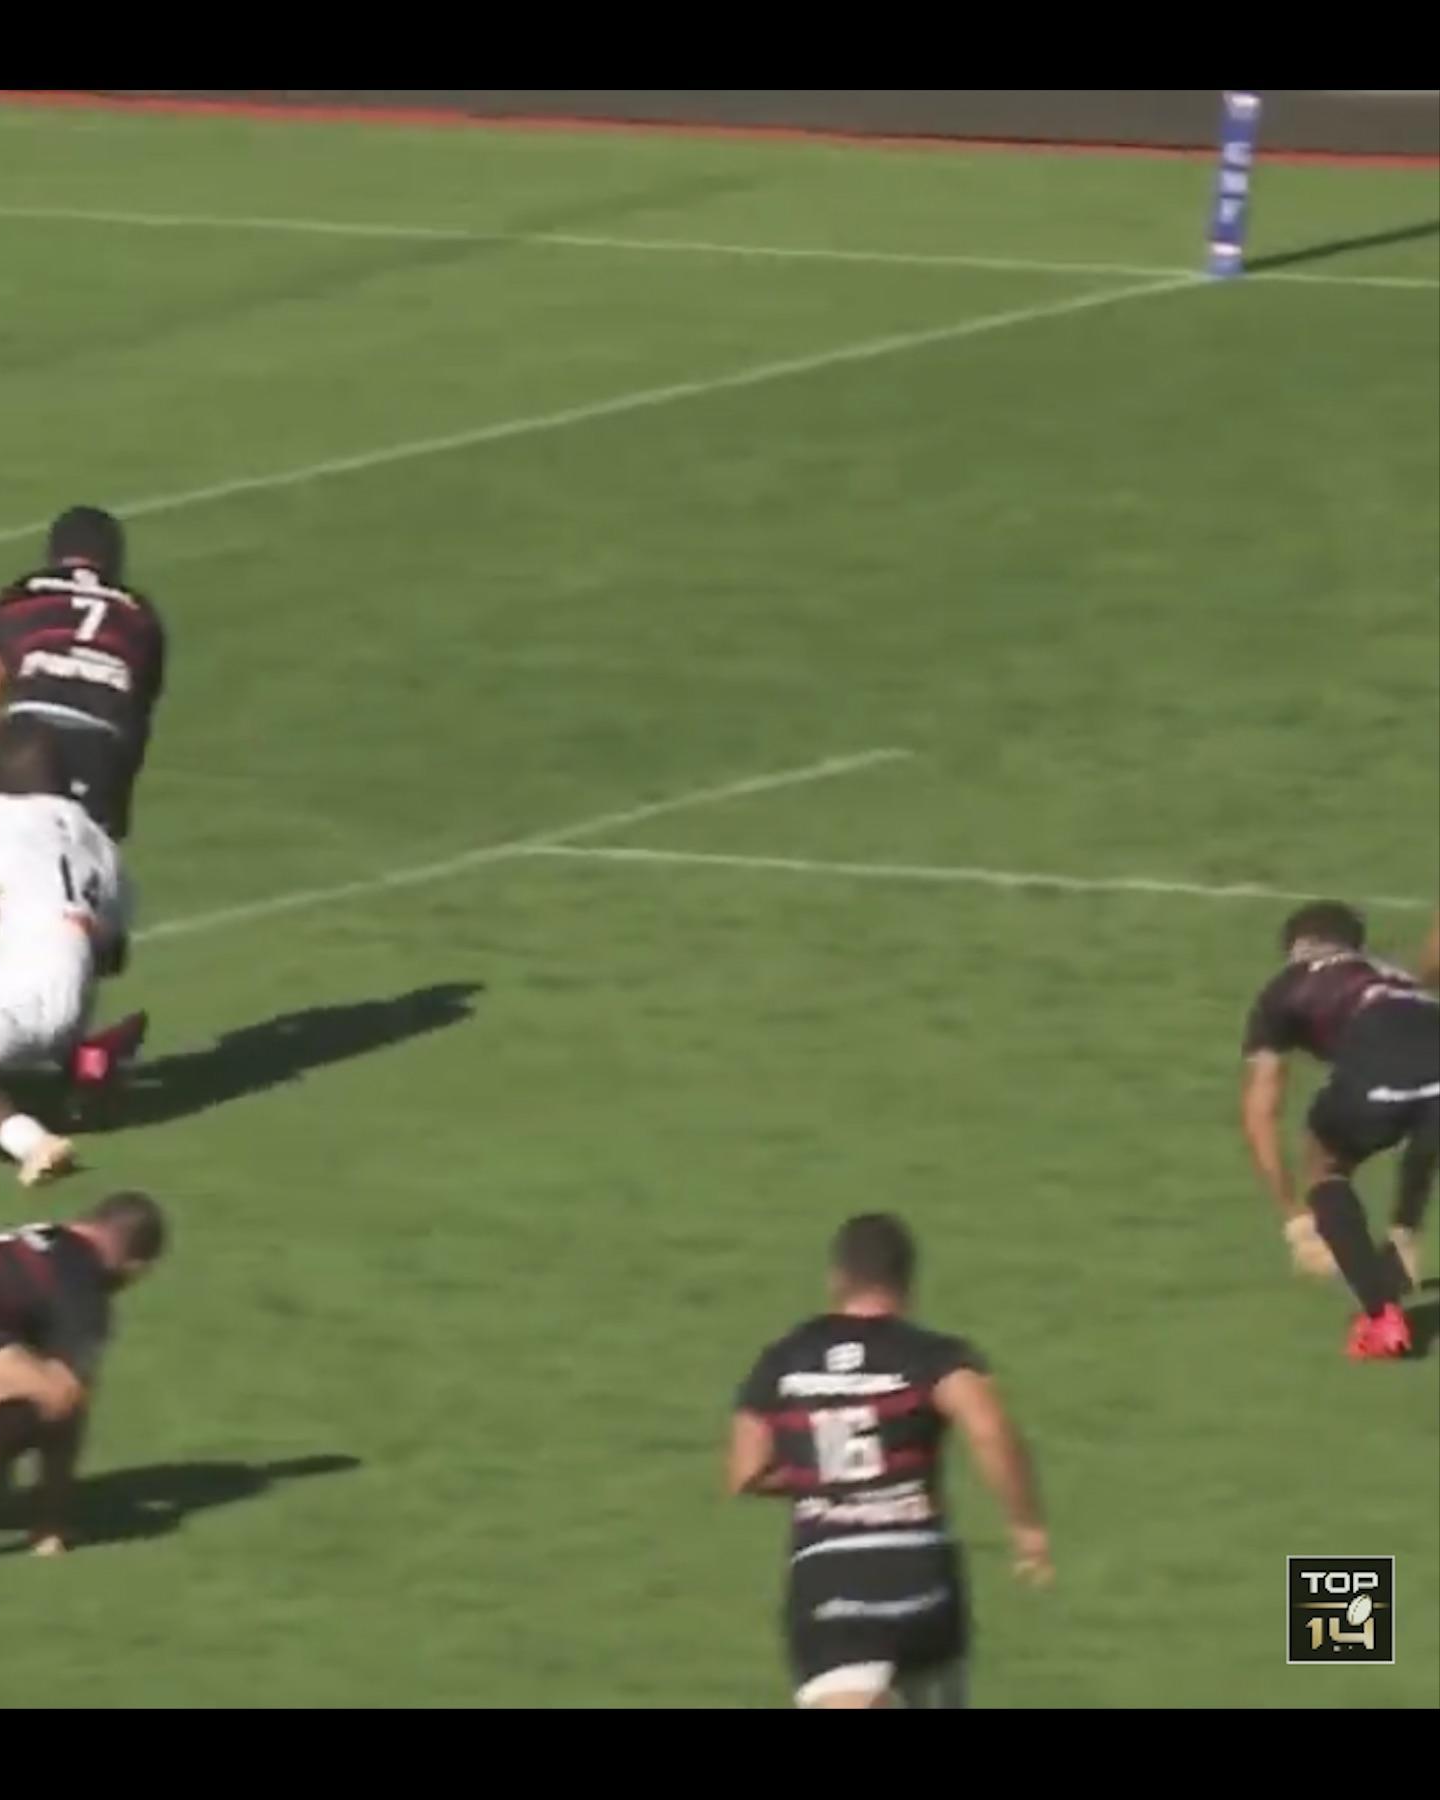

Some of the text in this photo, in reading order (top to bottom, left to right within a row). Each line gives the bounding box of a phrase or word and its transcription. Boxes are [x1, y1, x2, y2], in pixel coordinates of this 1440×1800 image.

[70, 596, 108, 642] 7
[60, 853, 102, 914] 14
[809, 1404, 886, 1482] 16
